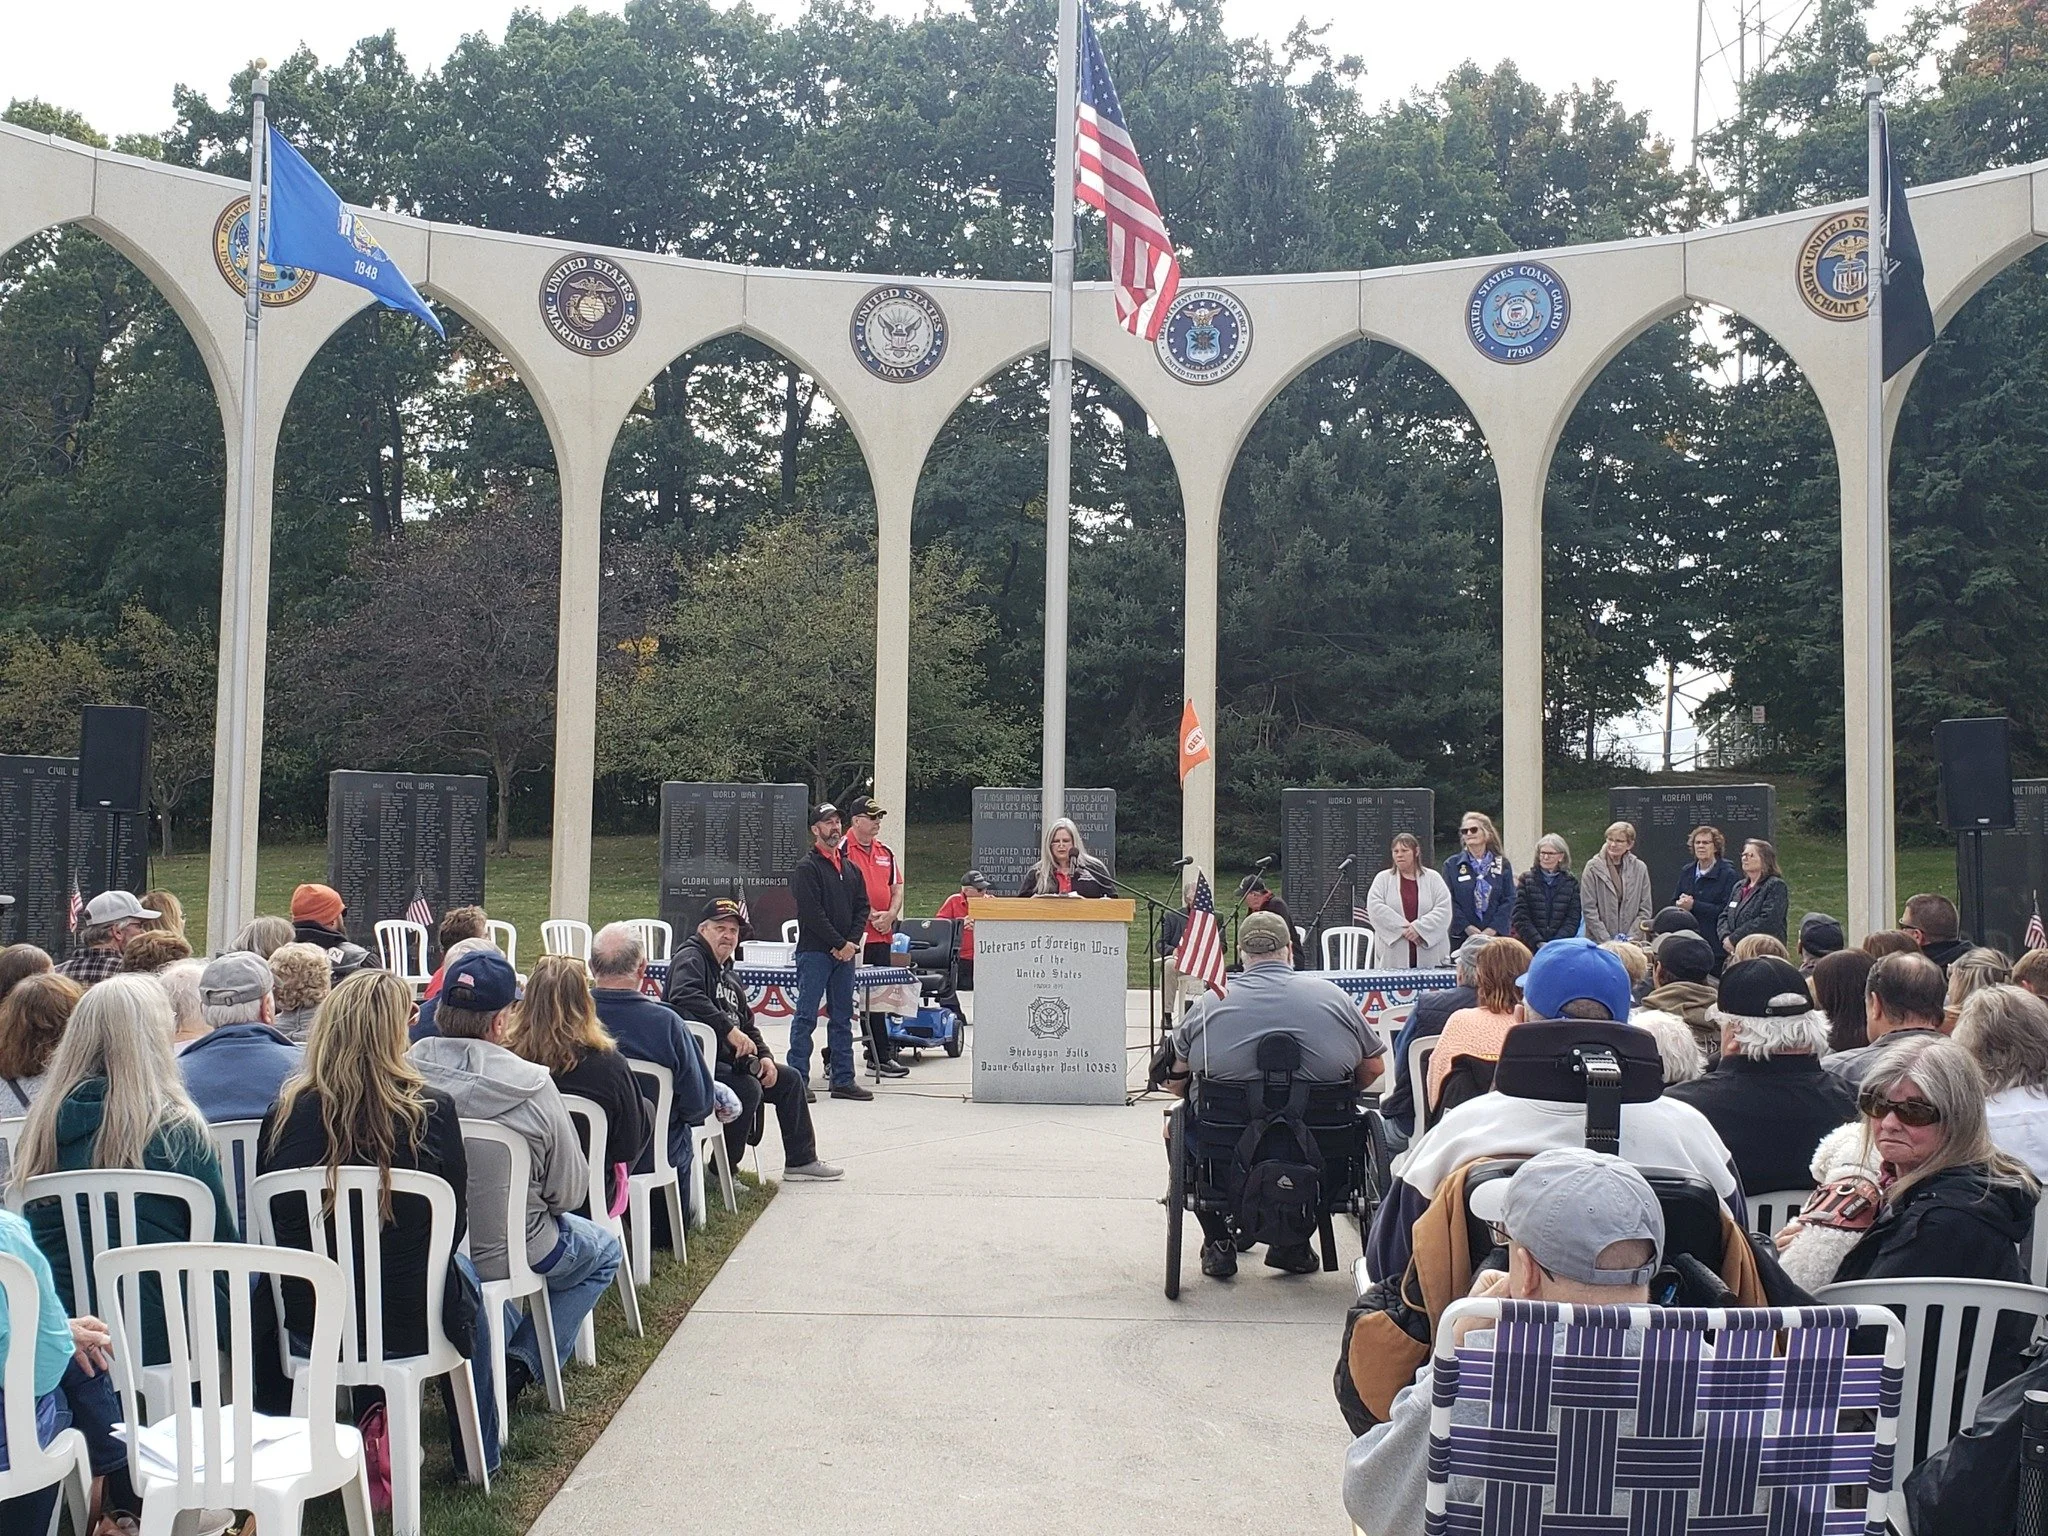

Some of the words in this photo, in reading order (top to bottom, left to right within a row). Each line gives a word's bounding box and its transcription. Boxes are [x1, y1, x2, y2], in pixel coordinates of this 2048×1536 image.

[1805, 218, 1848, 260] UNITED
[354, 260, 378, 280] 1848
[288, 271, 313, 299] AMERIC
[546, 257, 588, 293] UNITED
[593, 258, 635, 302] STATES
[1802, 265, 1860, 314] MERCHANT
[856, 288, 900, 327] UNITED
[904, 289, 943, 332] STATES
[1470, 300, 1486, 343] UNITED
[1478, 267, 1514, 297] STATES
[1519, 266, 1554, 287] COAST
[1550, 289, 1563, 330] GUARD
[1193, 291, 1206, 299] OF
[1207, 291, 1223, 301] THE
[1224, 298, 1239, 312] AIR
[1236, 310, 1249, 336] FORCE
[546, 304, 592, 350] MARINE
[597, 313, 636, 350] CORPS
[1506, 345, 1534, 358] 1790
[877, 363, 919, 378] NAVY
[1164, 355, 1186, 376] UNITED
[1186, 372, 1209, 380] STATES
[1220, 350, 1243, 374] AMERICA
[47, 766, 68, 776] CIVIL
[395, 781, 414, 790] CIVIL
[418, 782, 435, 790] WAR
[2012, 785, 2047, 795] VIETNAM
[712, 790, 737, 799] WORLD
[740, 791, 757, 799] WAR
[1090, 794, 1109, 803] SUCH
[1661, 793, 1691, 802] KOREAN
[1695, 793, 1713, 801] WAR
[1328, 797, 1352, 805] WORLD
[1356, 797, 1373, 805] WAR
[1377, 797, 1383, 805] II
[979, 802, 1019, 811] PRIVILEGES
[1021, 802, 1031, 811] AS
[1071, 803, 1098, 812] FORGET
[996, 811, 1012, 820] THAT
[979, 847, 1019, 856] DEDICATED
[1022, 847, 1031, 856] TO
[1095, 849, 1108, 857] THE
[979, 856, 995, 865] MEN
[999, 856, 1015, 865] AND
[979, 864, 1006, 874] COUNTY
[1007, 864, 1023, 873] WHO
[681, 877, 710, 886] GLOBAL
[713, 877, 731, 886] WAR
[747, 877, 788, 886] TERRORISM
[1012, 874, 1019, 882] IN
[979, 940, 1026, 954] Veterans
[1031, 936, 1042, 949] of
[1044, 935, 1086, 953] Foreign
[1091, 940, 1120, 956] Wars
[1034, 954, 1044, 964] of
[1050, 954, 1065, 965] the
[1016, 968, 1046, 979] United
[1052, 968, 1082, 979] States
[1009, 1046, 1058, 1059] Sheboygan
[1065, 1047, 1089, 1058] Falls
[1060, 1062, 1080, 1074] Post
[1086, 1062, 1117, 1073] 10383
